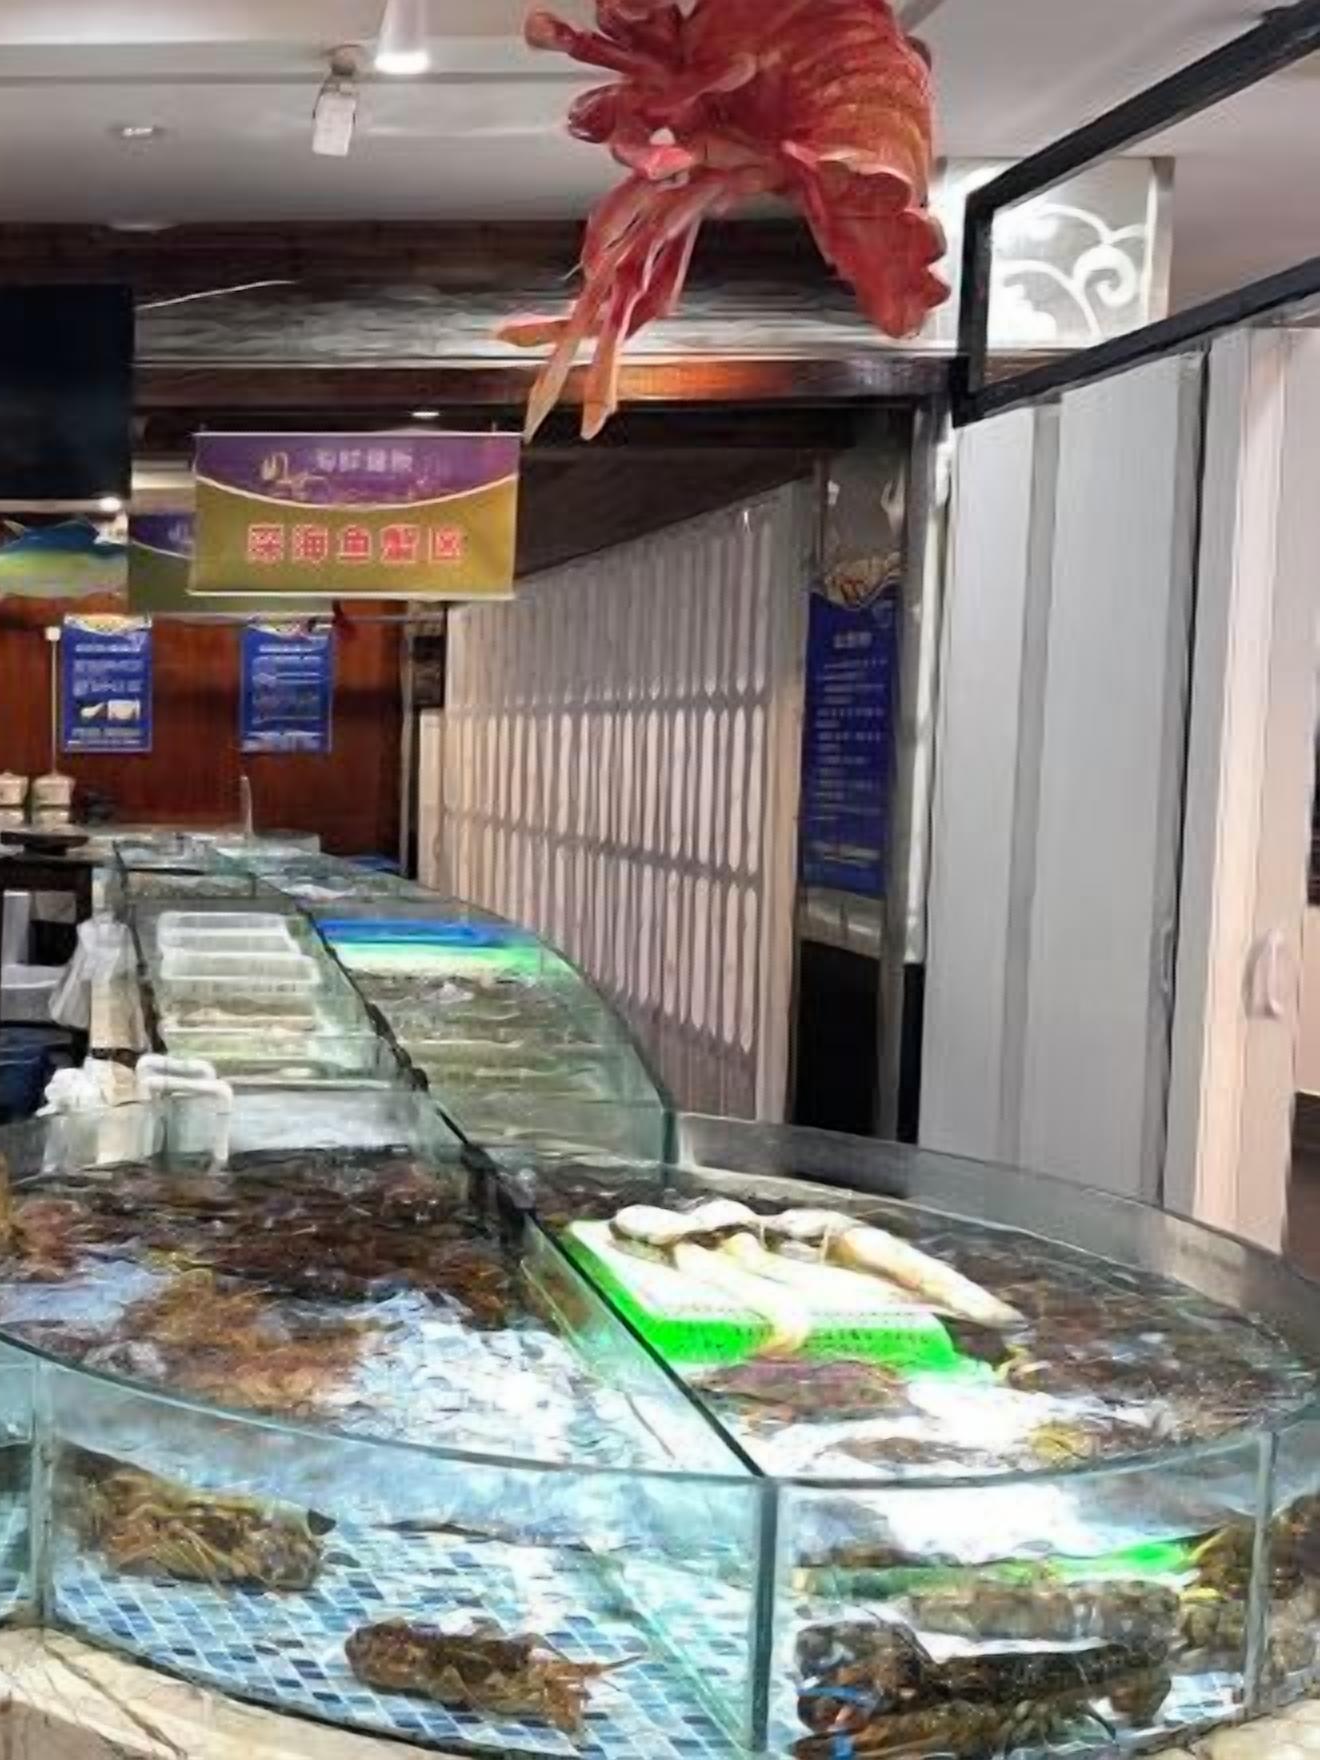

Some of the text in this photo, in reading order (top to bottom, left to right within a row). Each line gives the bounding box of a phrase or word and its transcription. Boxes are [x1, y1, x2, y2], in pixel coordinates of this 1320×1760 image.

[247, 523, 463, 565] 深海鱼蟹区
